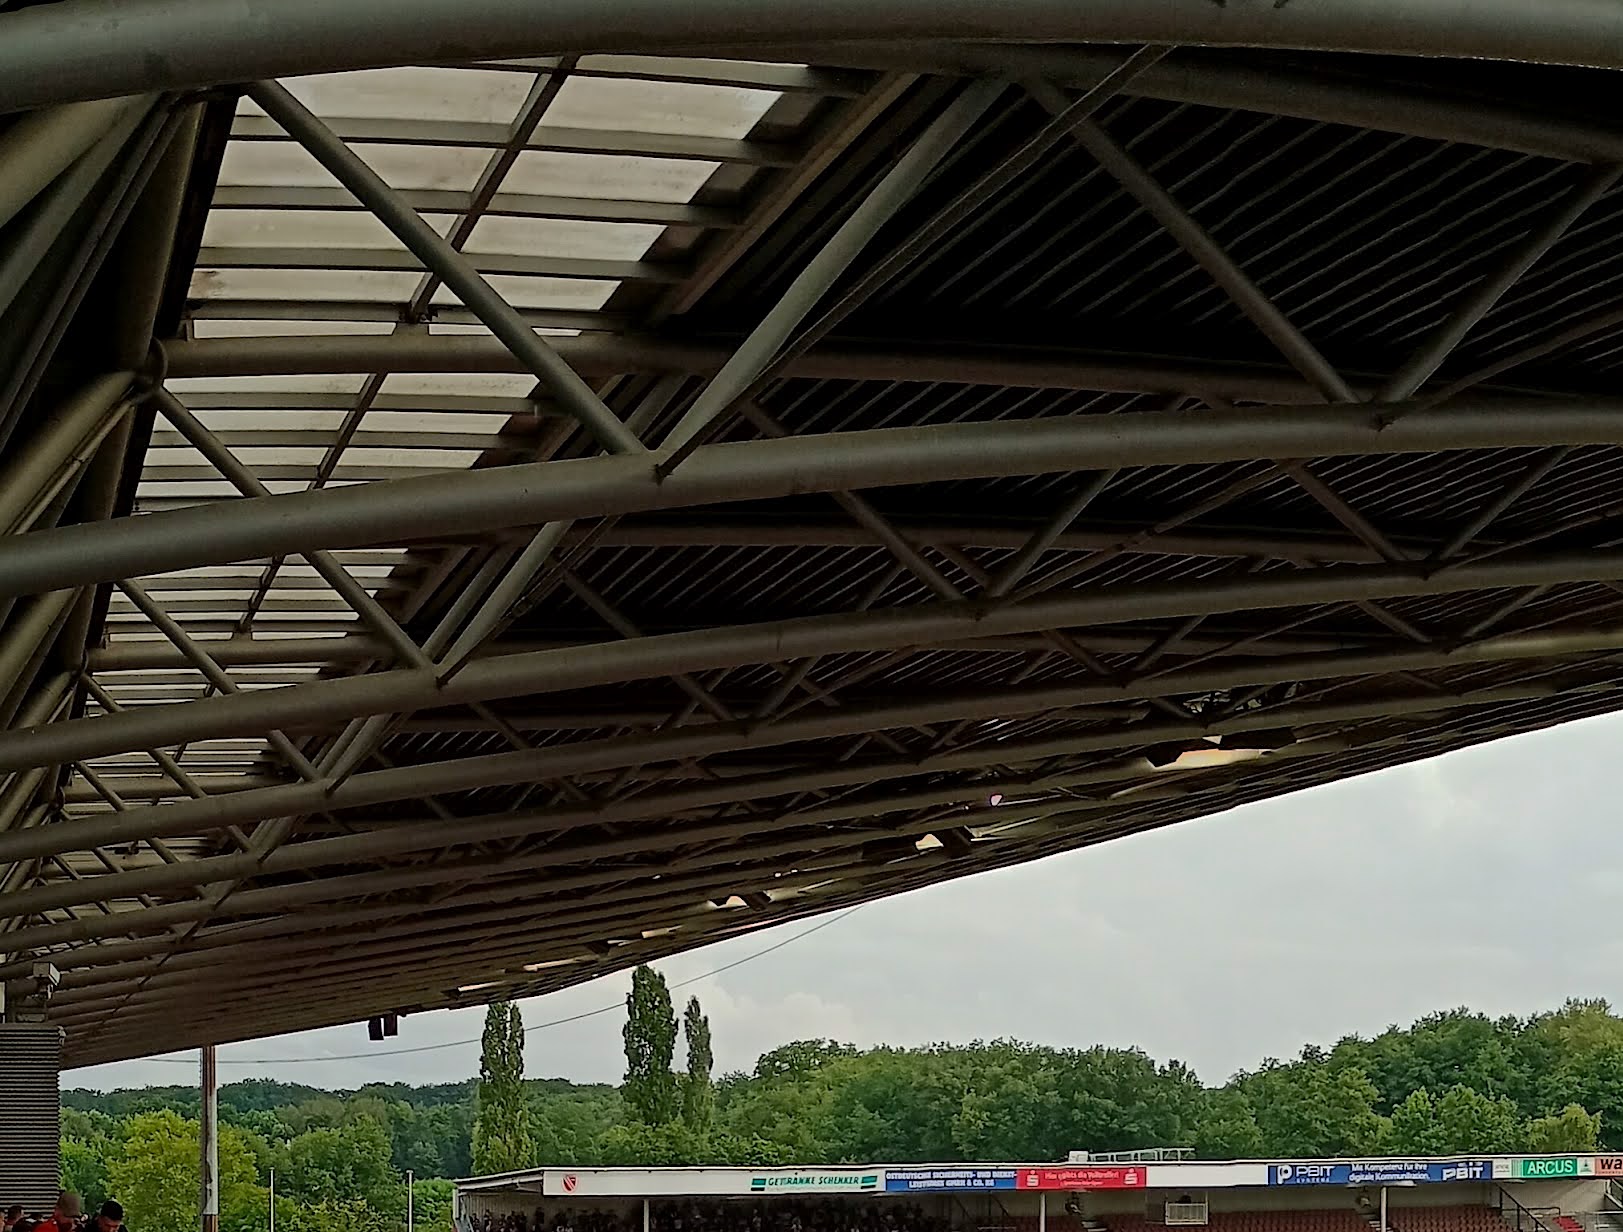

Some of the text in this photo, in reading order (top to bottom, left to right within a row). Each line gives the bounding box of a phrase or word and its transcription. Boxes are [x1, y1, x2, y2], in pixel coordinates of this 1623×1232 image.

[1365, 1163, 1403, 1172] Kompetenz
[1527, 1160, 1574, 1175] ARCUS
[976, 1170, 991, 1179] UND
[1349, 1173, 1374, 1182] digitale
[818, 1175, 859, 1185] SCHENKER
